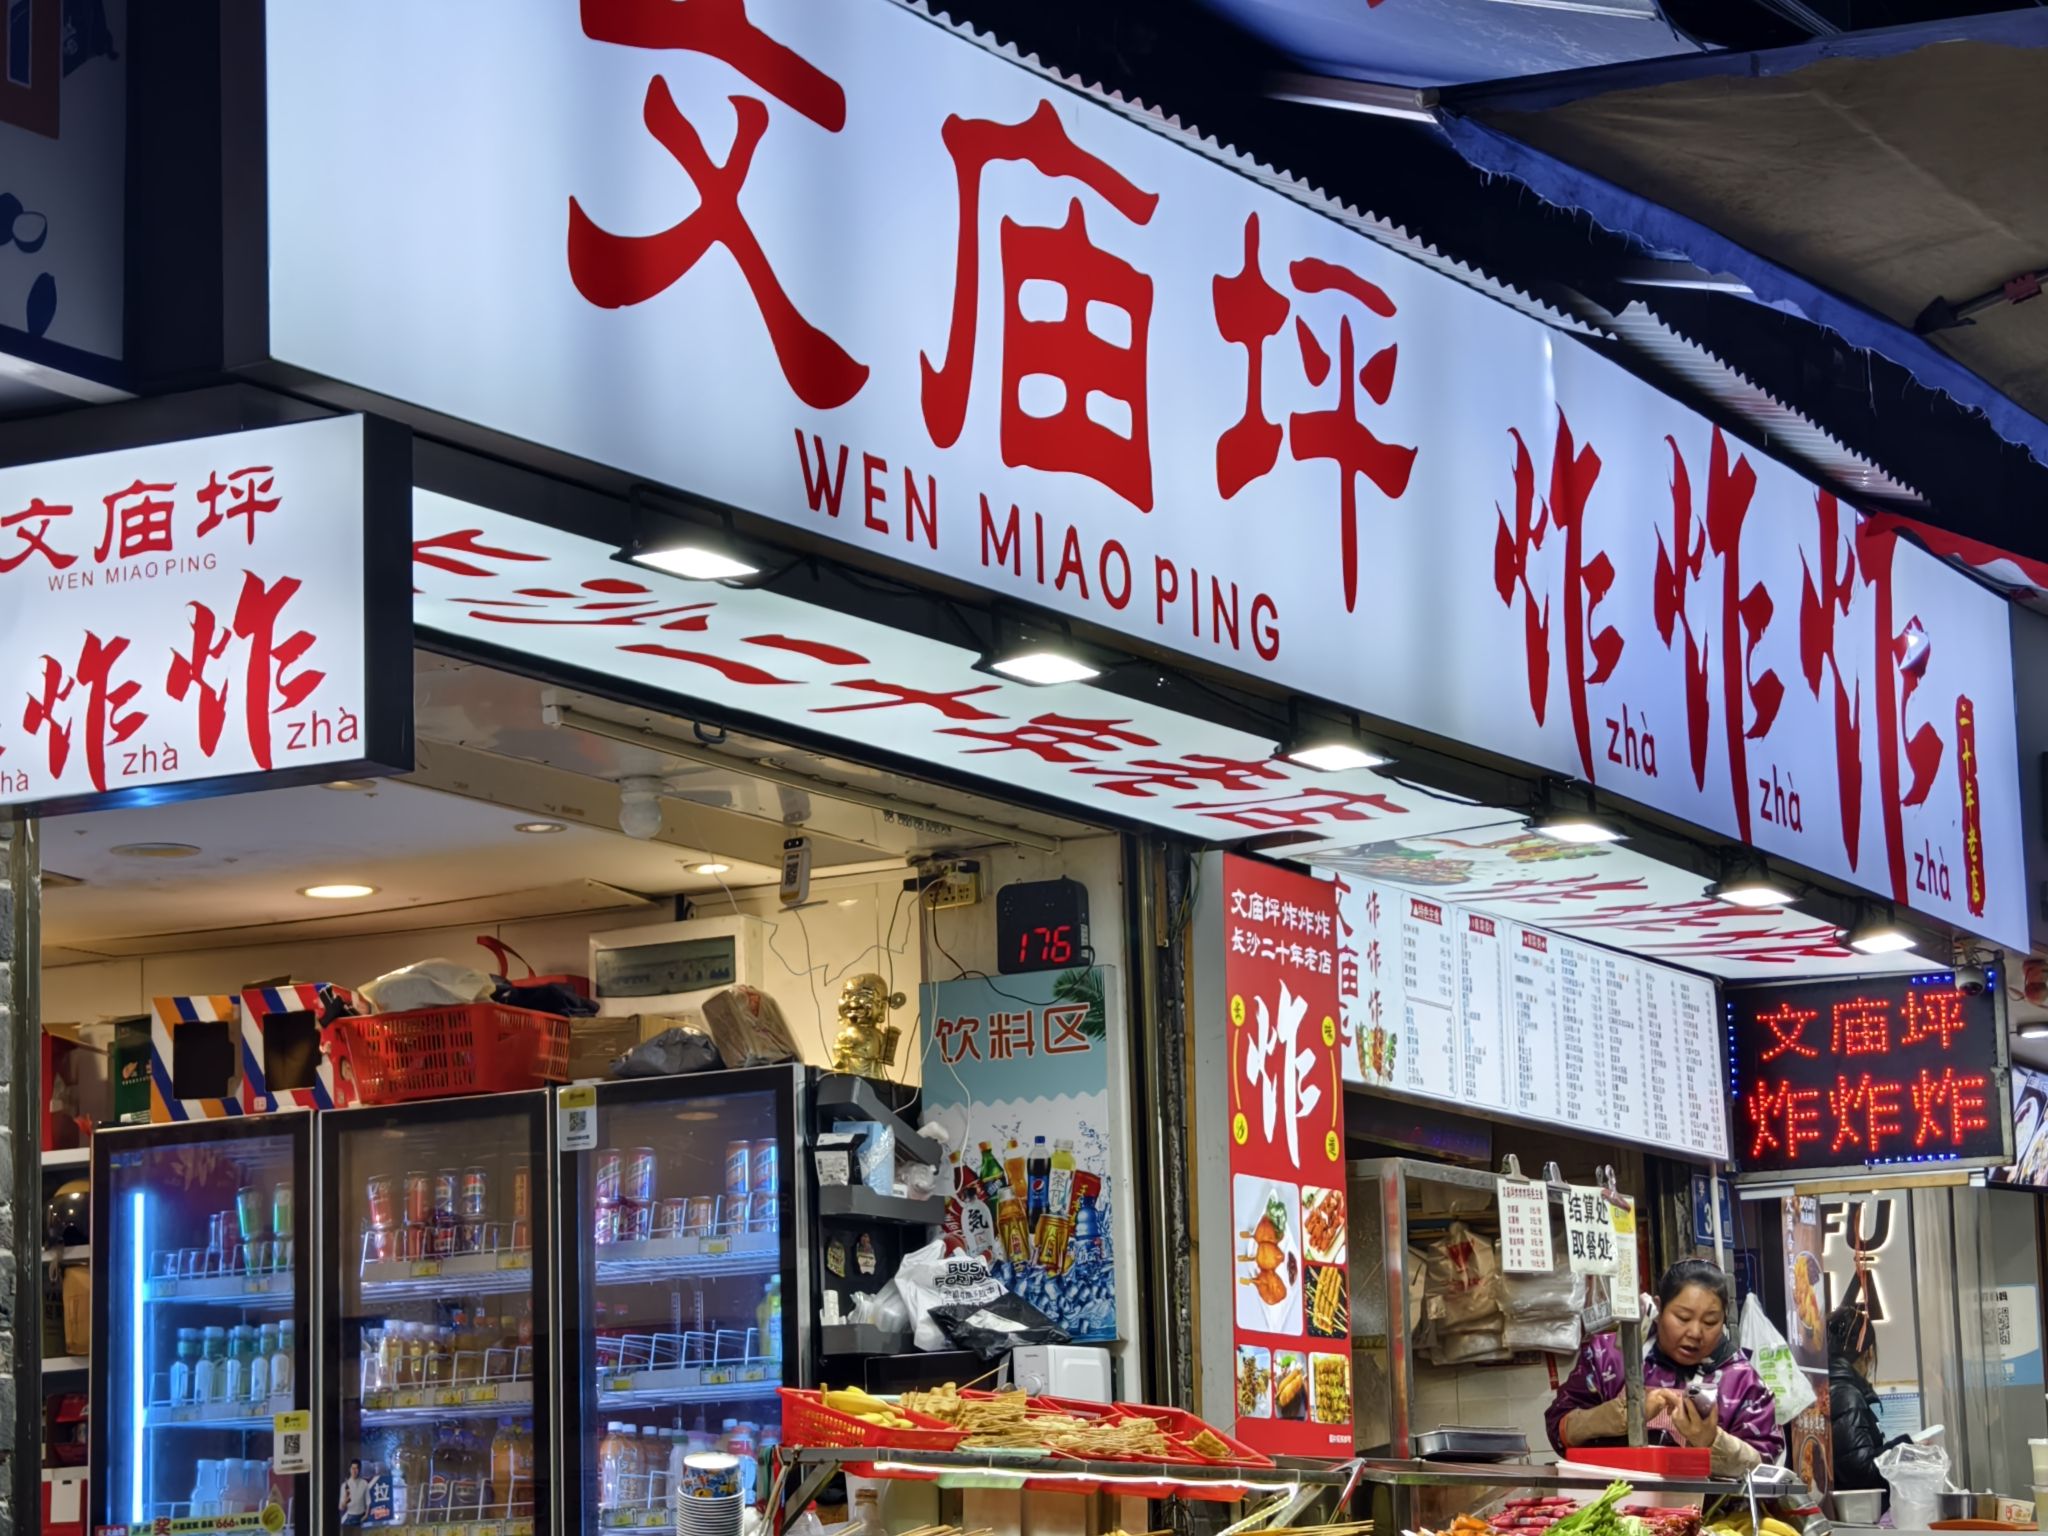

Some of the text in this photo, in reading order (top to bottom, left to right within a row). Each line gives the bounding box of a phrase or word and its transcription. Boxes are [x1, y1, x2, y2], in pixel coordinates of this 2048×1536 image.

[568, 0, 1418, 614] 文庙坪
[0, 465, 283, 573] 文庙坪
[795, 428, 1281, 662] WEN MIAO PING
[48, 553, 217, 591] WEN MIAO PING
[1494, 400, 1943, 908] 炸炸炸
[122, 742, 179, 776] zhà
[286, 708, 359, 750] zhà
[1606, 702, 1658, 778] zhà
[0, 768, 29, 792] hà
[1759, 764, 1804, 834] zhà
[1957, 703, 1981, 904] 二十年老店
[1914, 838, 1952, 902] zhà
[1019, 925, 1071, 964] 176
[1231, 888, 1331, 940] 文庙坪炸炸炸
[1231, 926, 1332, 975] 长沙二十年老店
[934, 1003, 1091, 1063] 饮料区
[1756, 986, 1968, 1061] 文庙坪
[1246, 978, 1321, 1169] 炸
[1747, 1065, 1988, 1159] 炸炸炸
[1569, 1193, 1609, 1225] 结算处
[1571, 1229, 1612, 1261] 取餐处
